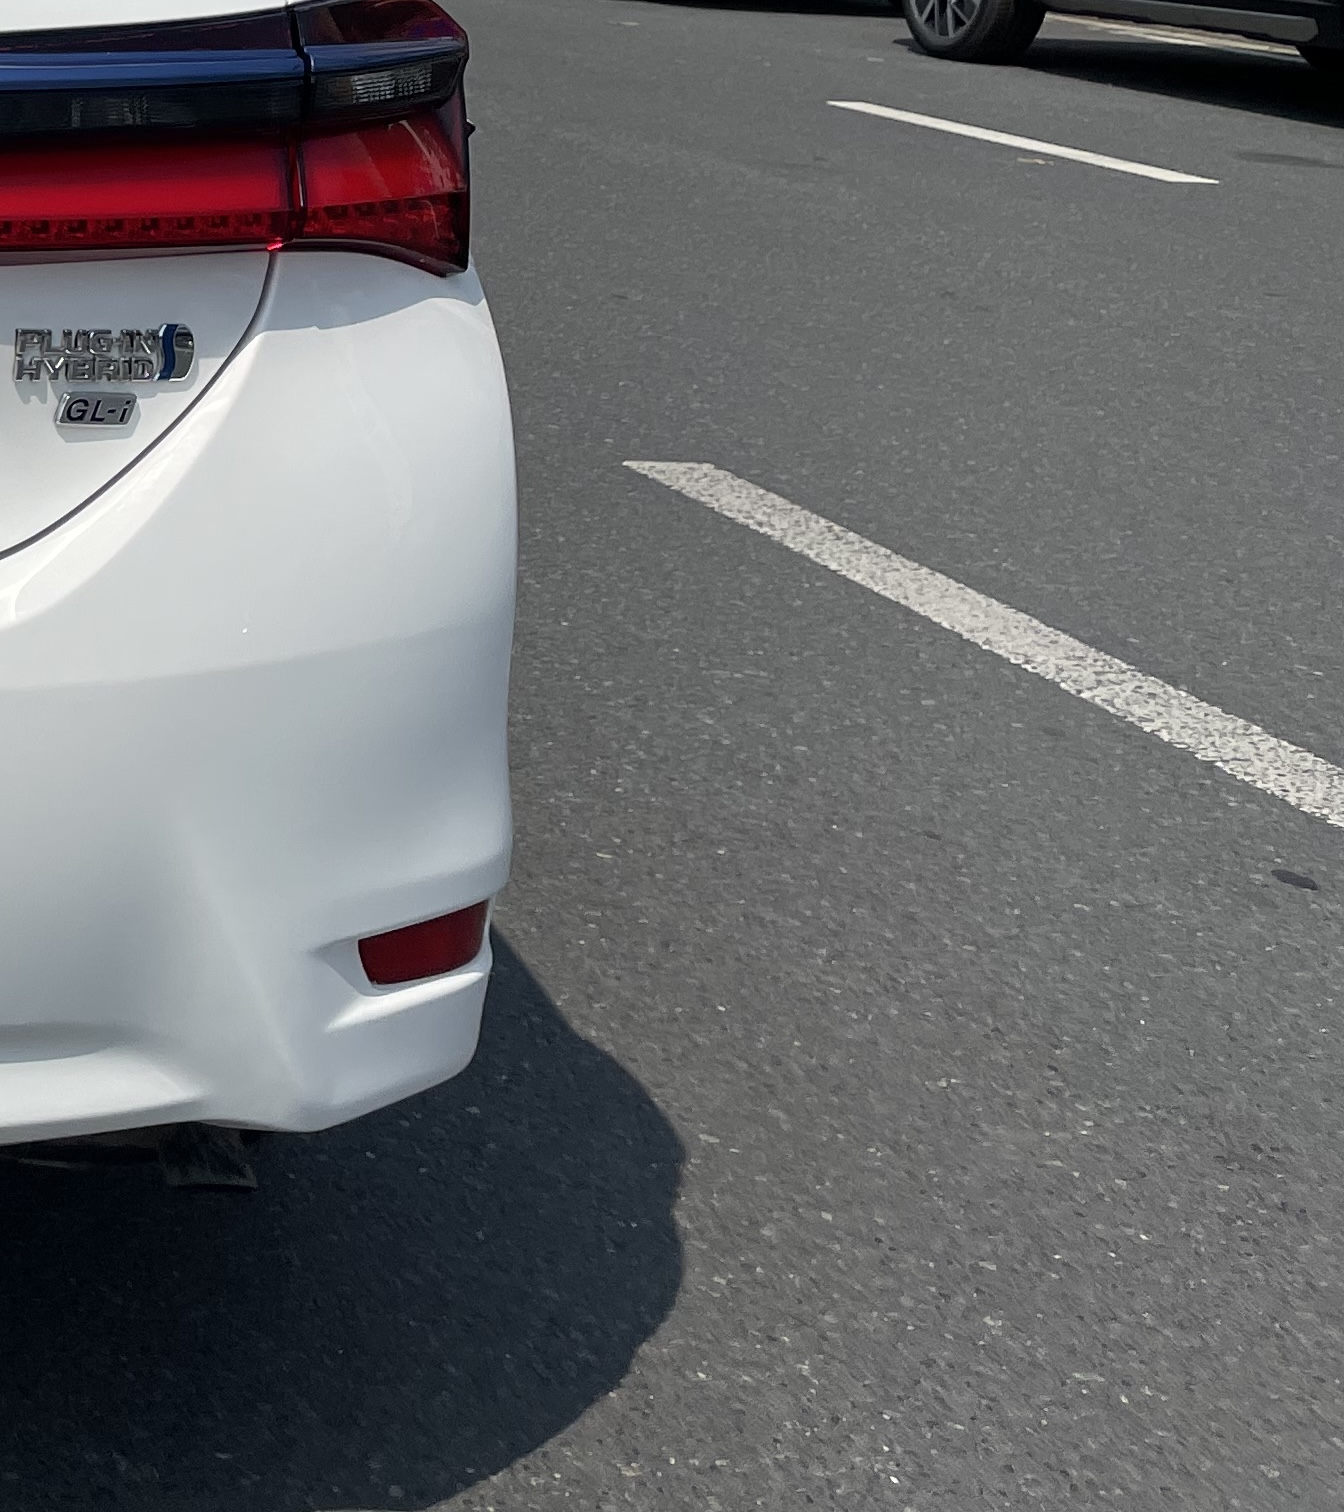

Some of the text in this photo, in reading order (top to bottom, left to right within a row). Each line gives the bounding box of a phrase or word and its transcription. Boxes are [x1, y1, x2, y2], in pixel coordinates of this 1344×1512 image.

[15, 328, 160, 355] PLUG-IN
[15, 356, 158, 382] HYBRID
[66, 399, 134, 423] GL-i
